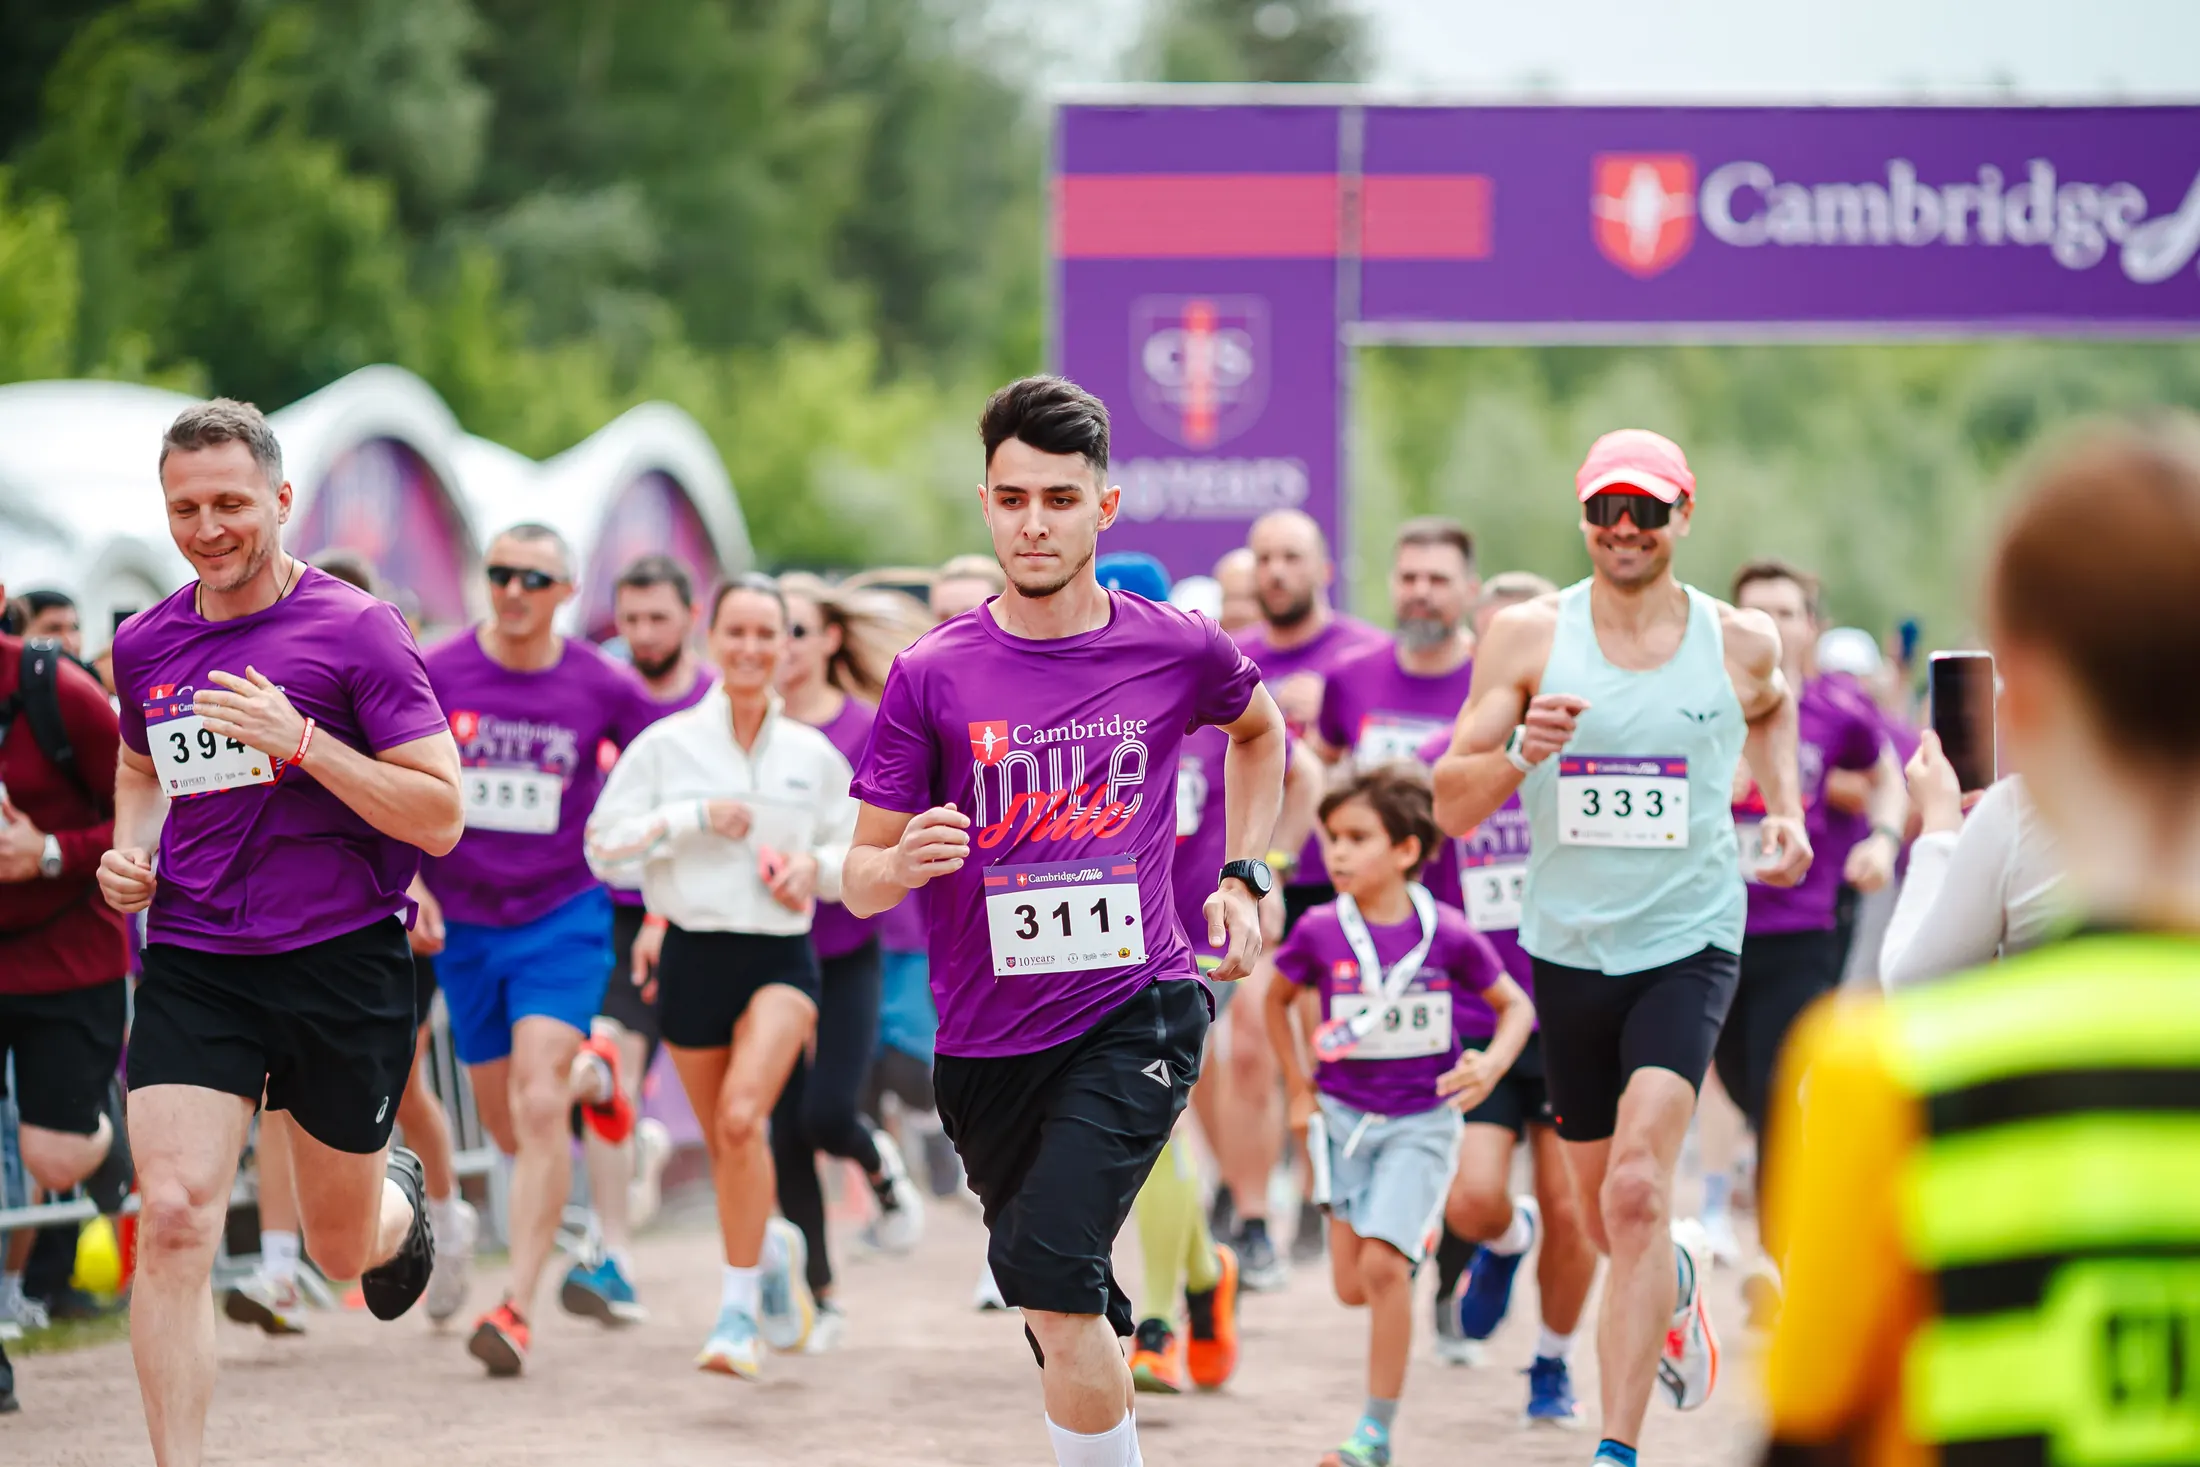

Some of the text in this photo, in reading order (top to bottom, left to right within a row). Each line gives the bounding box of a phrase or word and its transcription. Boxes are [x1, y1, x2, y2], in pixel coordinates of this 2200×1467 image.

[1700, 158, 2147, 269] Cambridge
[1012, 714, 1148, 745] Cambridge
[1583, 789, 1664, 818] 333
[1014, 897, 1110, 940] 311
[1019, 957, 1031, 967] 10
